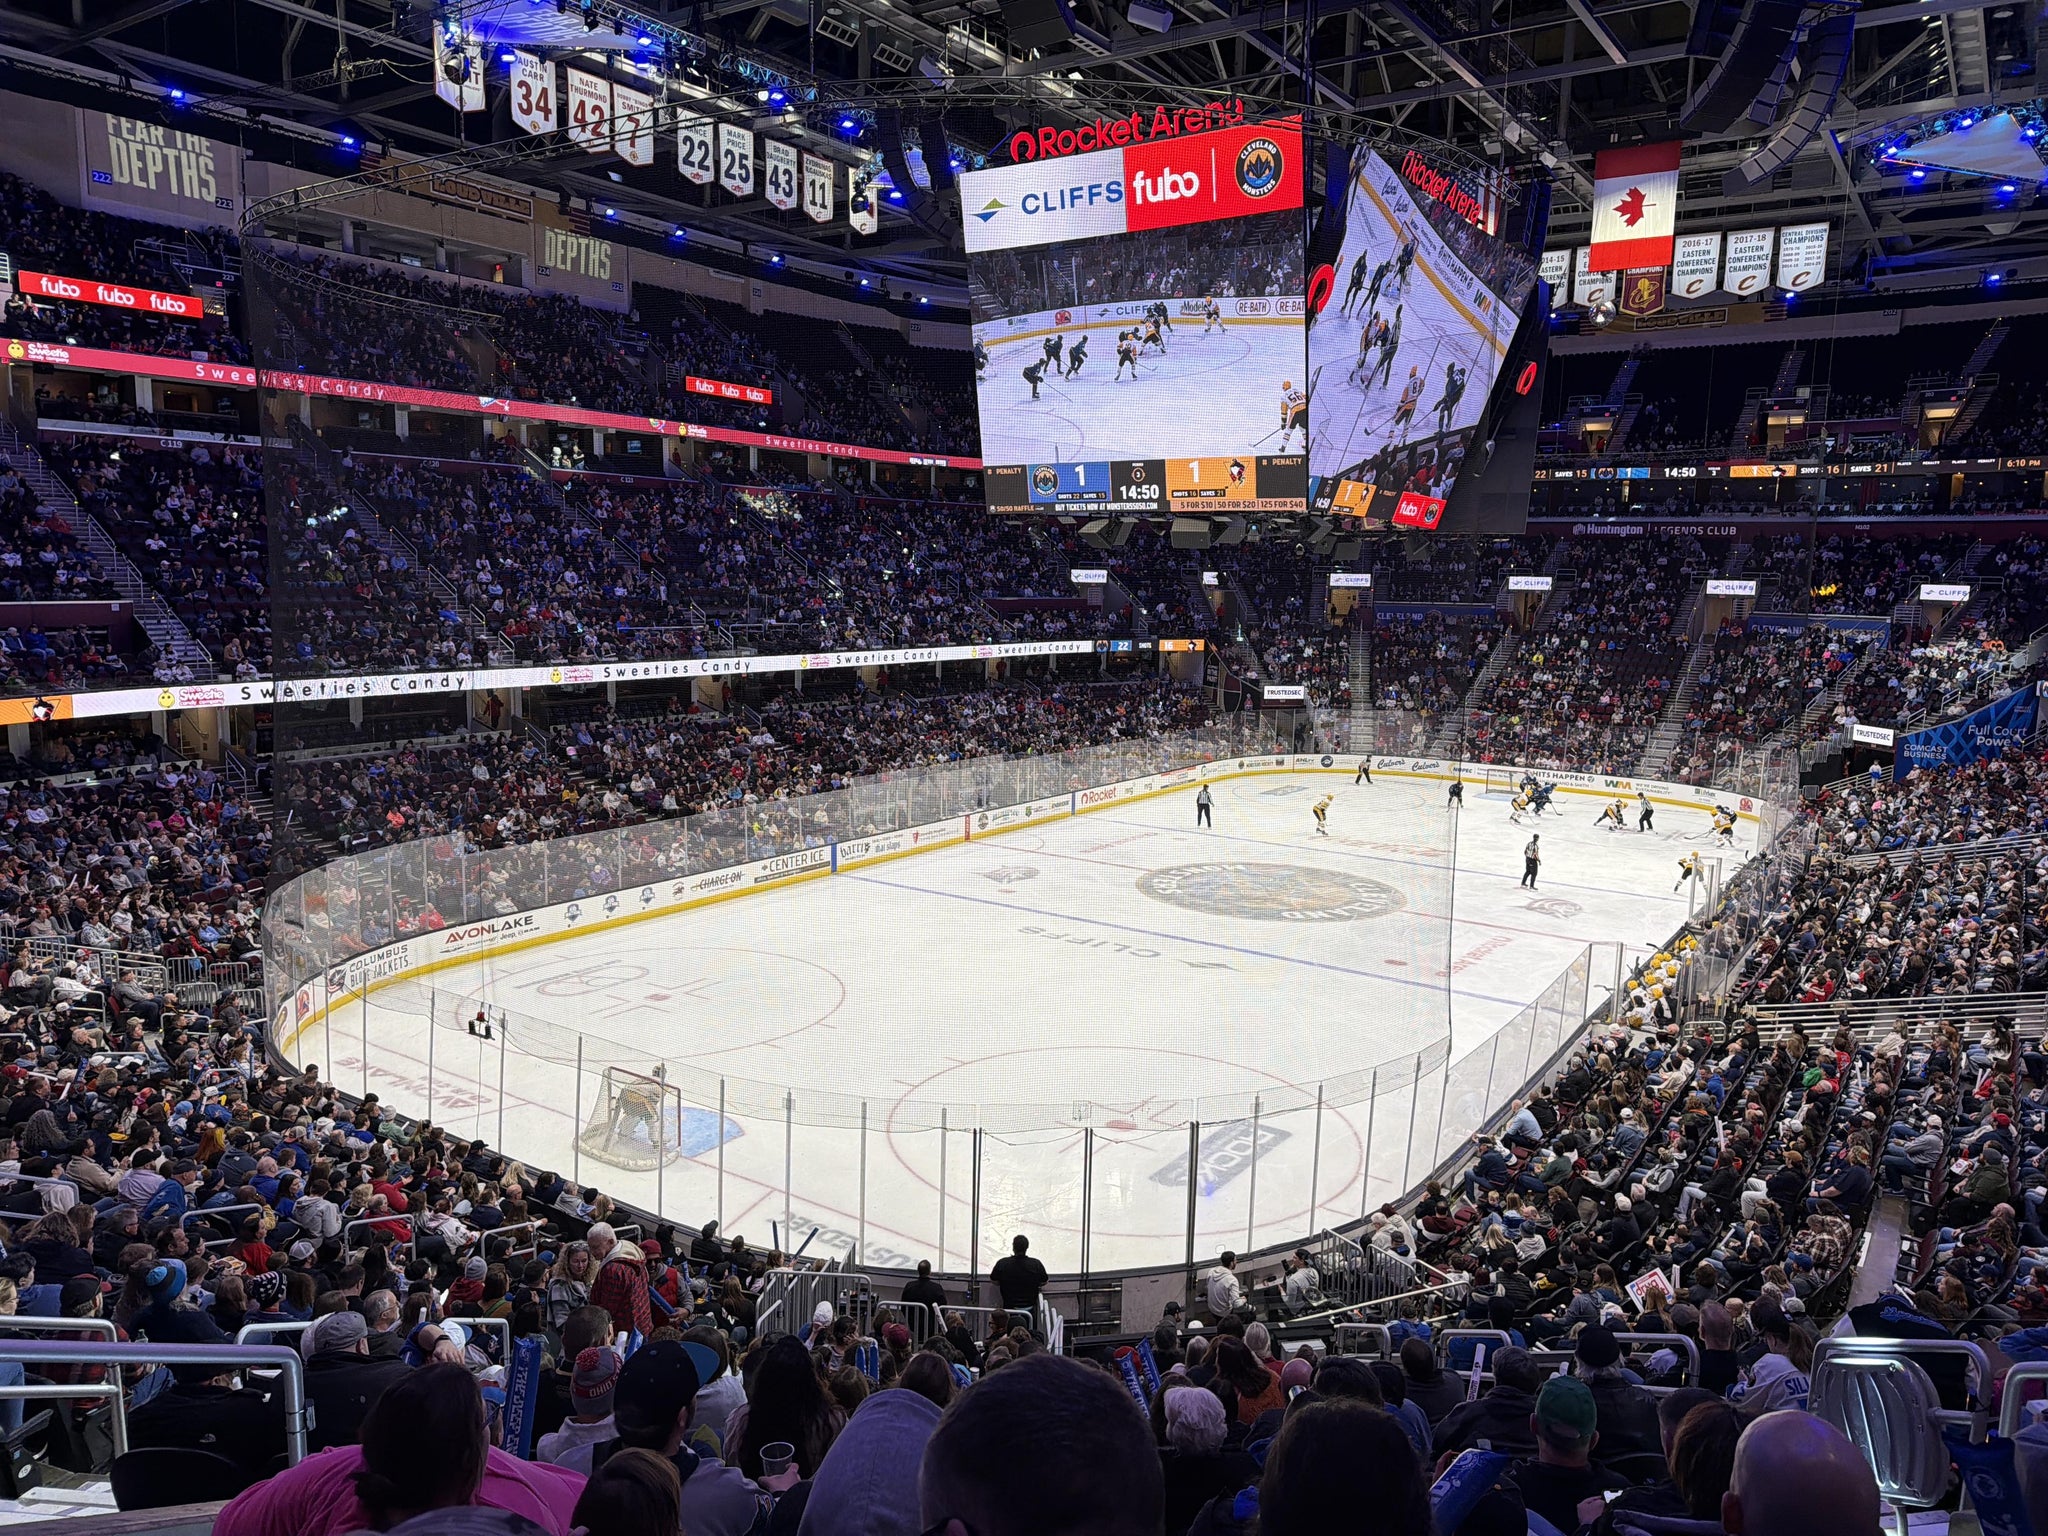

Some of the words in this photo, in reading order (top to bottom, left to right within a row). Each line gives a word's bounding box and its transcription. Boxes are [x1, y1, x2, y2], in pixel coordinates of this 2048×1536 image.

[517, 56, 548, 74] AUSTIN
[522, 68, 544, 82] CARR
[579, 77, 599, 91] NATE
[517, 80, 552, 122] 34
[570, 84, 608, 104] THURMOND
[574, 100, 606, 137] 42
[627, 115, 640, 148] 7
[1038, 112, 1144, 158] Rocket
[1150, 98, 1244, 139] Arena
[105, 113, 164, 147] FEAR
[175, 130, 214, 158] THE
[726, 129, 746, 142] MARK
[726, 137, 746, 150] PRICE
[1241, 139, 1277, 160] CLEVELAND
[682, 135, 710, 172] 22
[108, 135, 217, 202] DEPTHS
[724, 148, 750, 184] 25
[92, 172, 112, 184] 222
[769, 165, 794, 198] 43
[1133, 167, 1200, 204] fubo
[1242, 177, 1277, 196] MONSTERS
[1408, 154, 1450, 202] Rocket
[1445, 181, 1482, 225] Arena
[809, 178, 827, 210] 11
[1021, 181, 1124, 214] CLIFFS
[216, 199, 233, 210] 223
[1734, 234, 1767, 244] 2017-18
[1805, 228, 1828, 236] DIVISION
[1682, 238, 1713, 248] 2016-17
[1783, 234, 1825, 245] CHAMPIONS
[545, 230, 612, 280] DEPTHS
[1682, 249, 1711, 258] EASTERN
[1734, 245, 1765, 254] EASTERN
[1676, 257, 1716, 268] CONFERENCE
[1728, 253, 1770, 264] CONFERENCE
[1677, 266, 1714, 276] CHAMPIONS
[1728, 262, 1767, 273] CHAMPIONS
[1578, 277, 1612, 286] CHAMPIONS
[40, 277, 80, 297] fubo
[97, 286, 135, 306] fubo
[150, 294, 186, 313] fubo
[28, 343, 69, 358] Sweetie
[28, 354, 46, 362] candy
[320, 379, 384, 400] Candy
[695, 380, 715, 393] fubo
[721, 384, 740, 397] fubo
[746, 387, 764, 401] fubo
[167, 440, 183, 449] 119
[766, 436, 820, 451] Sweeties
[827, 443, 860, 458] Candy
[2006, 459, 2026, 468] 6:10
[996, 467, 1021, 475] PENALTY
[1074, 464, 1085, 486] 1
[1188, 461, 1199, 483] 1
[1272, 458, 1302, 466] PENALTY
[1534, 470, 1546, 478] 22
[1554, 470, 1573, 478] SAVES
[1576, 470, 1587, 478] 15
[1625, 468, 1631, 477] 1
[1664, 467, 1696, 478] 14:50
[1826, 465, 1840, 474] 16
[1850, 465, 1872, 473] SAVES
[1874, 464, 1888, 473] 21
[1120, 485, 1160, 500] 14:50
[1066, 503, 1086, 511] TICKETS
[1186, 501, 1200, 509] FOR
[1243, 500, 1256, 508] $20
[1261, 500, 1273, 508] 125
[1274, 500, 1288, 508] FOR
[1289, 500, 1304, 508] $40
[1400, 501, 1418, 516] fubo
[1586, 523, 1643, 537] Huntington
[1654, 526, 1704, 535] LEGENDS
[1707, 526, 1737, 535] CLUB
[1084, 572, 1106, 580] CLIFFS
[1938, 589, 1968, 597] CLIFFS
[998, 644, 1043, 655] Sweeties
[1048, 642, 1081, 652] Candy
[1118, 642, 1129, 650] 22
[1164, 642, 1173, 650] 16
[836, 652, 895, 665] Sweeties
[904, 650, 939, 661] Candy
[604, 663, 688, 678] Sweeties
[701, 660, 751, 673] Candy
[179, 688, 225, 701] Sweetie
[241, 681, 371, 700] Sweeties
[391, 675, 465, 691] Candy
[1266, 688, 1302, 697] TRUSTEDSEC
[1856, 729, 1891, 742] TRUSTEDSEC
[1968, 724, 1990, 735] Full
[1993, 726, 2027, 737] Court
[1904, 744, 1949, 753] COMCAST
[1976, 736, 2011, 747] Powe
[1903, 751, 1947, 760] BUSINESS
[1377, 758, 1406, 770] Culver's
[1412, 760, 1440, 772] Culver's
[1533, 770, 1551, 778] HITS
[1552, 772, 1586, 781] HAPPEN
[1604, 779, 1632, 790] WM
[1089, 787, 1117, 804] Rocket
[769, 854, 808, 873] CENTER
[810, 849, 825, 862] ICE
[445, 915, 535, 945] AVONLAKE
[1017, 925, 1163, 960] CLIFFS
[349, 944, 409, 973] COLUMBUS
[350, 971, 371, 988] BLUE
[372, 955, 410, 980] JACKETS
[1635, 1279, 1659, 1296] drug
[589, 1380, 612, 1398] OHIO
